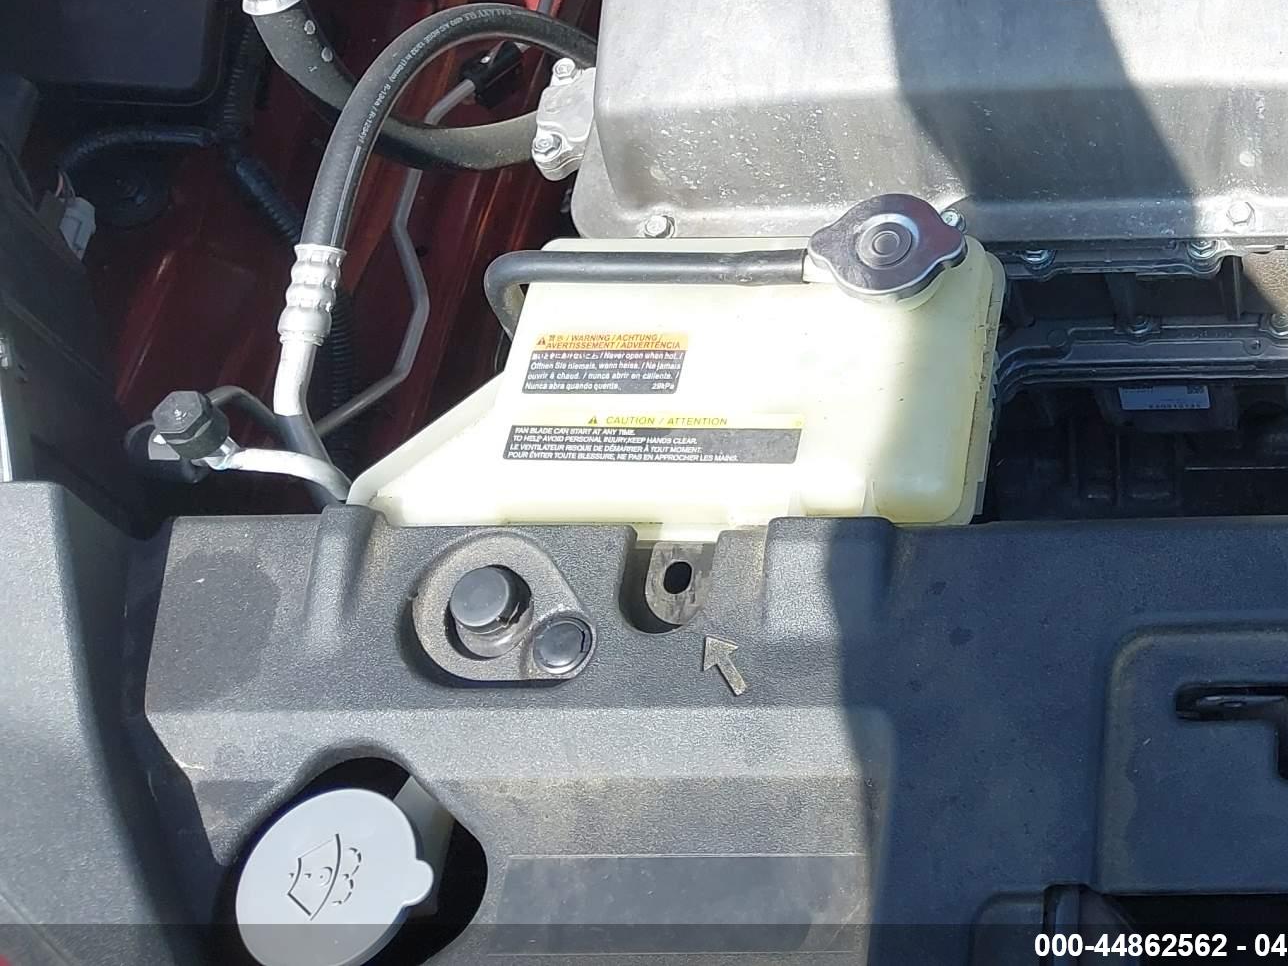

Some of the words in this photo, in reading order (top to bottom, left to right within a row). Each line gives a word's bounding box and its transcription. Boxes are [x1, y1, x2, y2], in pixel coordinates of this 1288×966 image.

[656, 362, 681, 371] jamais
[606, 416, 655, 425] CAUTION
[667, 417, 728, 425] ATTENTION
[529, 450, 553, 459] ÉVITER
[577, 452, 615, 460] BLESSURE,
